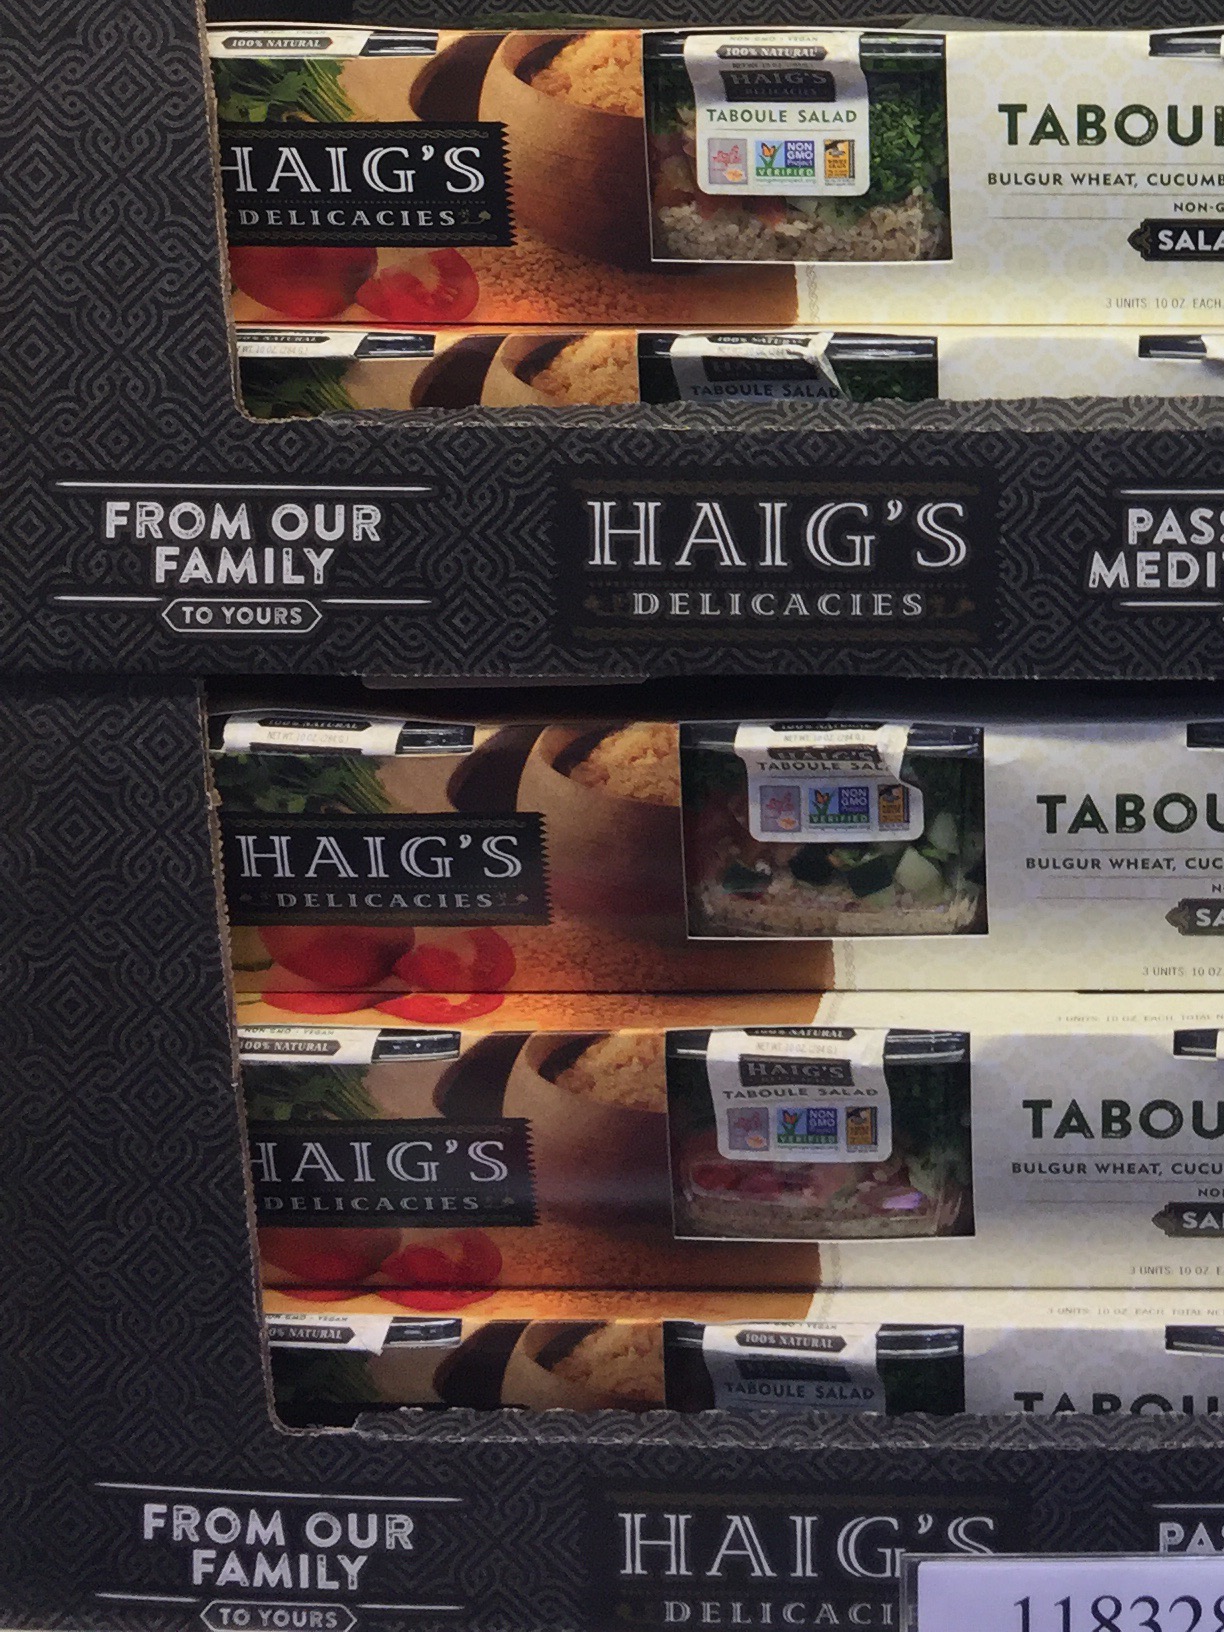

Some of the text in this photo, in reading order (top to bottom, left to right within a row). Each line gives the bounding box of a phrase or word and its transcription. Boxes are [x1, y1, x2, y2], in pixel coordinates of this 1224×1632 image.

[231, 39, 321, 48] 100% NATURAL
[706, 108, 858, 123] TABOULE SALAD
[786, 142, 813, 151] NON
[786, 151, 814, 160] GMO
[758, 168, 814, 177] VERIFIED
[987, 172, 1064, 187] BULGUR
[1071, 172, 1140, 189] WHEAT,
[239, 208, 457, 229] DELICACIES
[690, 384, 841, 399] TABOULE SALAD
[105, 501, 382, 543] FROM OUR
[586, 501, 968, 568] HAIG'S
[155, 547, 335, 585] FAMILY
[631, 592, 924, 618] DELICACIES
[182, 606, 302, 627] TO YOURS
[234, 834, 525, 879] HAIG'S
[1024, 856, 1102, 870] BULGUR
[1108, 856, 1177, 873] WHEAT,
[276, 892, 495, 911] DELICACIES
[273, 1042, 329, 1052] NATURAL
[747, 1062, 844, 1079] HAIG'S
[722, 1087, 809, 1100] TABOULE
[1011, 1161, 1088, 1176] BULGUR
[1094, 1161, 1163, 1178] WHEAT,
[265, 1195, 480, 1212] DELICACIES
[288, 1328, 342, 1340] NATURAL
[745, 1333, 834, 1349] 100% NATURAL
[723, 1381, 876, 1400] TABOULE SALAD
[141, 1503, 415, 1551] FROM OUR
[191, 1548, 369, 1592] FAMILY
[219, 1607, 339, 1630] TO YOURS
[663, 1600, 916, 1626] DELICACI
